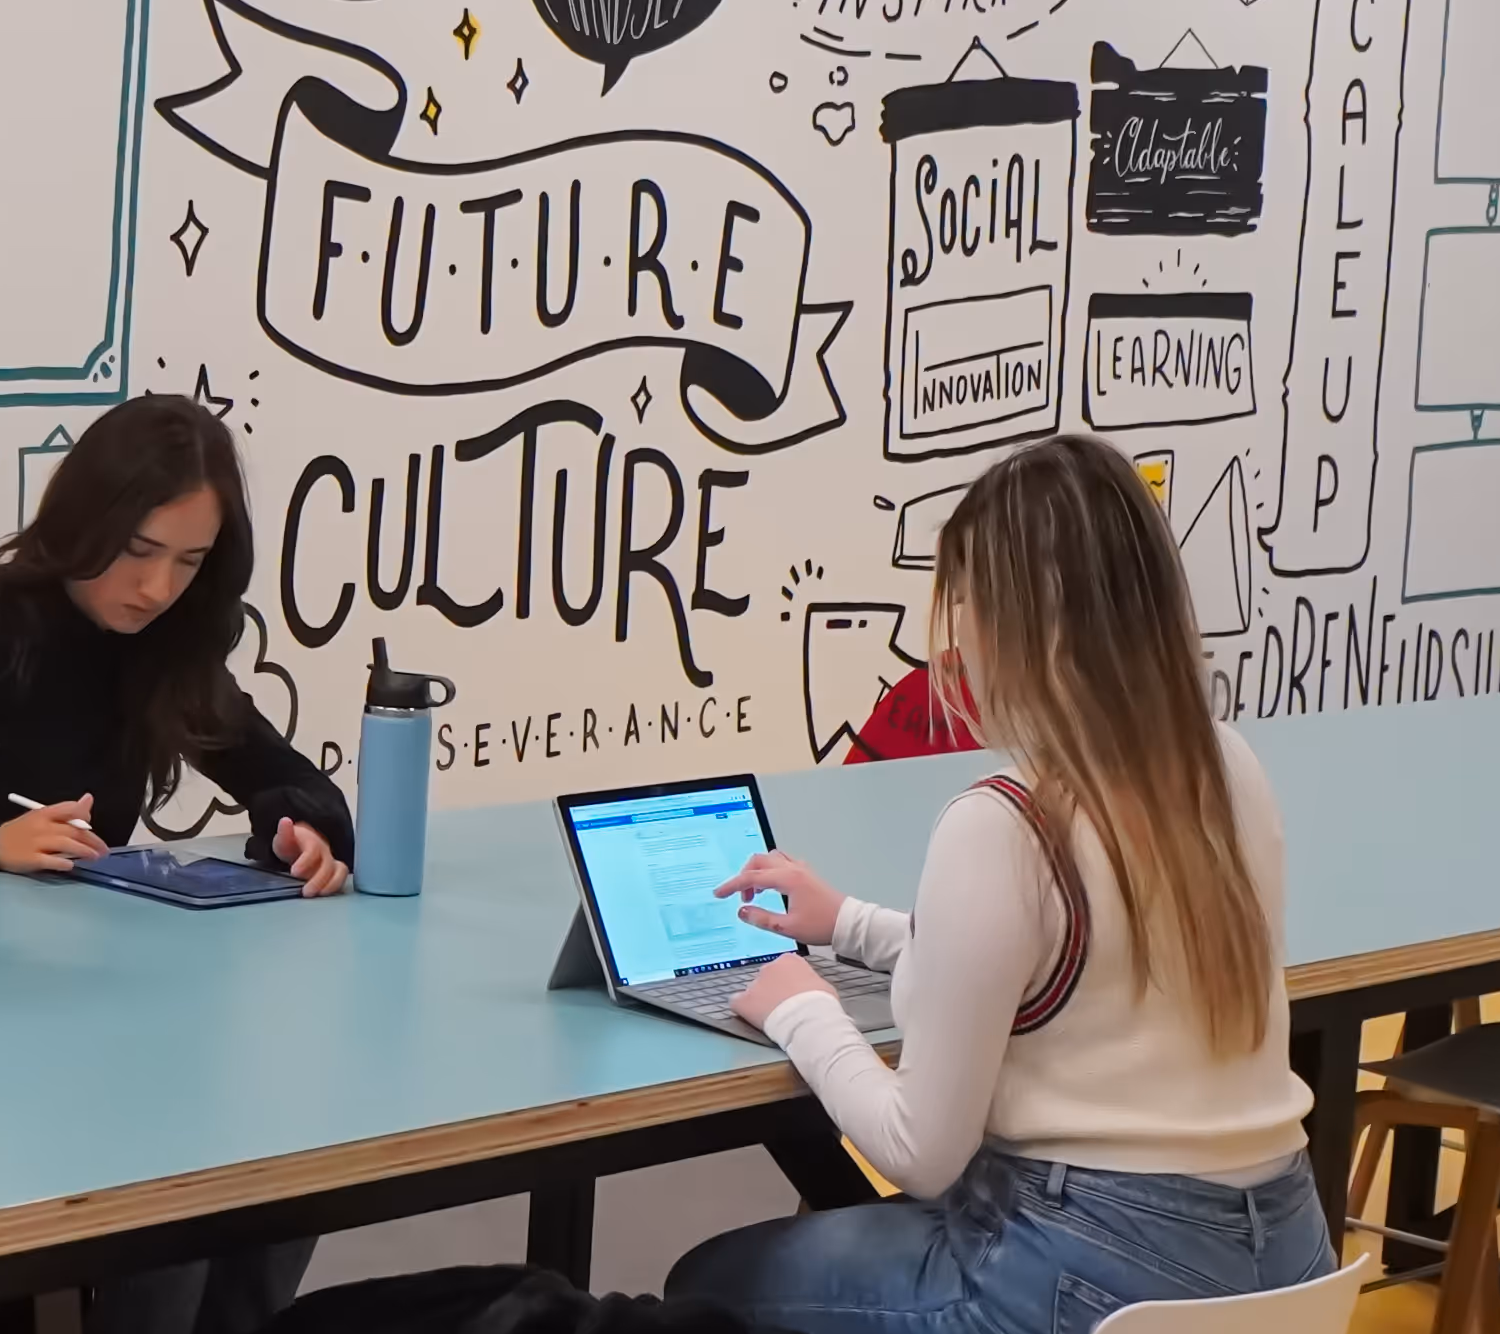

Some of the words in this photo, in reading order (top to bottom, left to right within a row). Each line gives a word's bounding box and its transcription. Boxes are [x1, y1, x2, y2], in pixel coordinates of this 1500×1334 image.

[1114, 116, 1231, 185] Adaptable
[913, 329, 1045, 420] INNOVATION
[1096, 328, 1245, 397] LEARNING
[1313, 355, 1353, 534] UP
[278, 398, 751, 688] CULTURE
